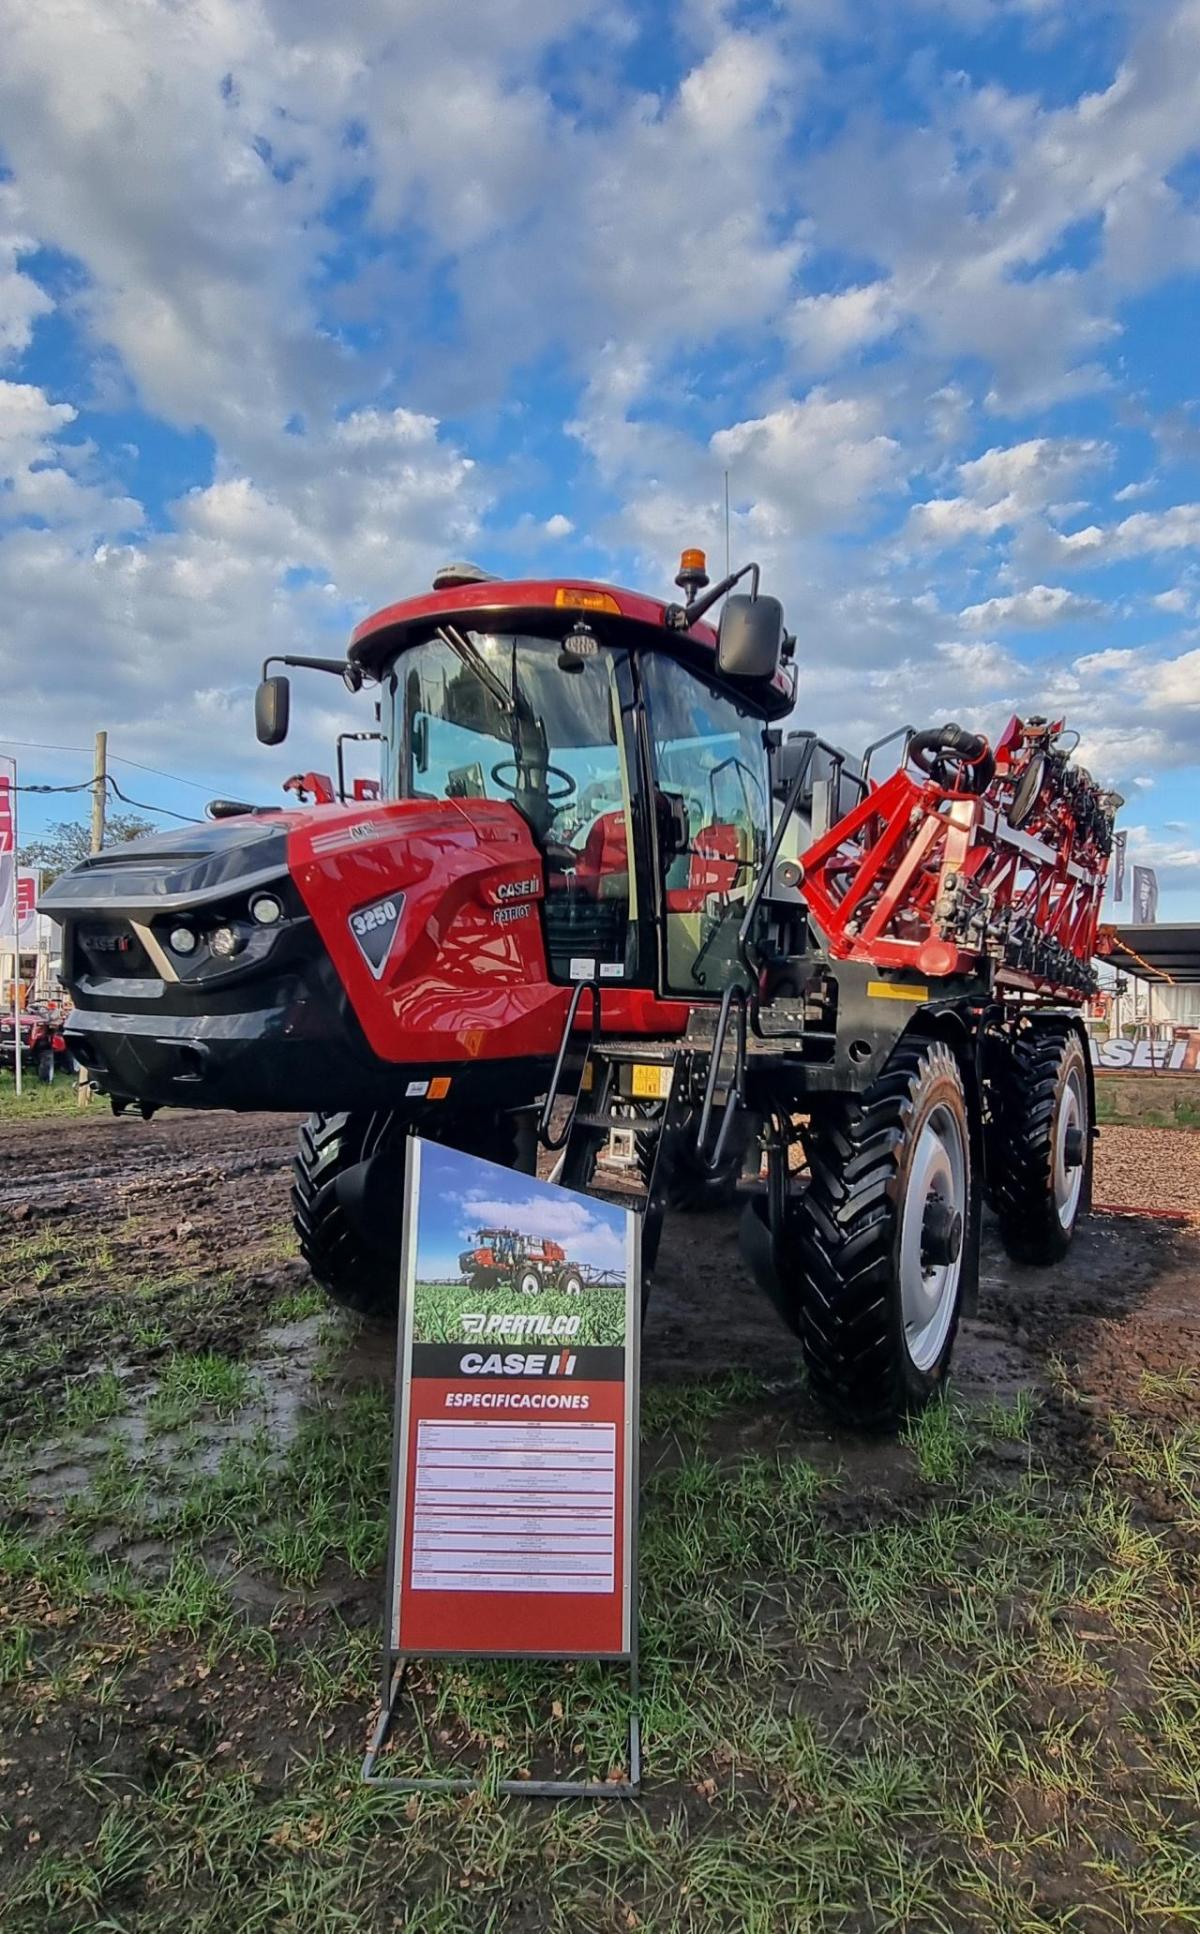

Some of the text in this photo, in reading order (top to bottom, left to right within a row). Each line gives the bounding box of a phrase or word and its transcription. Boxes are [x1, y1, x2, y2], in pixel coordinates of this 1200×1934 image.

[498, 880, 530, 898] CASE
[353, 901, 397, 935] 3250
[493, 904, 530, 923] PATRIOT
[485, 1314, 580, 1335] PERTILCO
[460, 1353, 547, 1375] CASE
[445, 1393, 590, 1409] ESPECIFICACIONES
